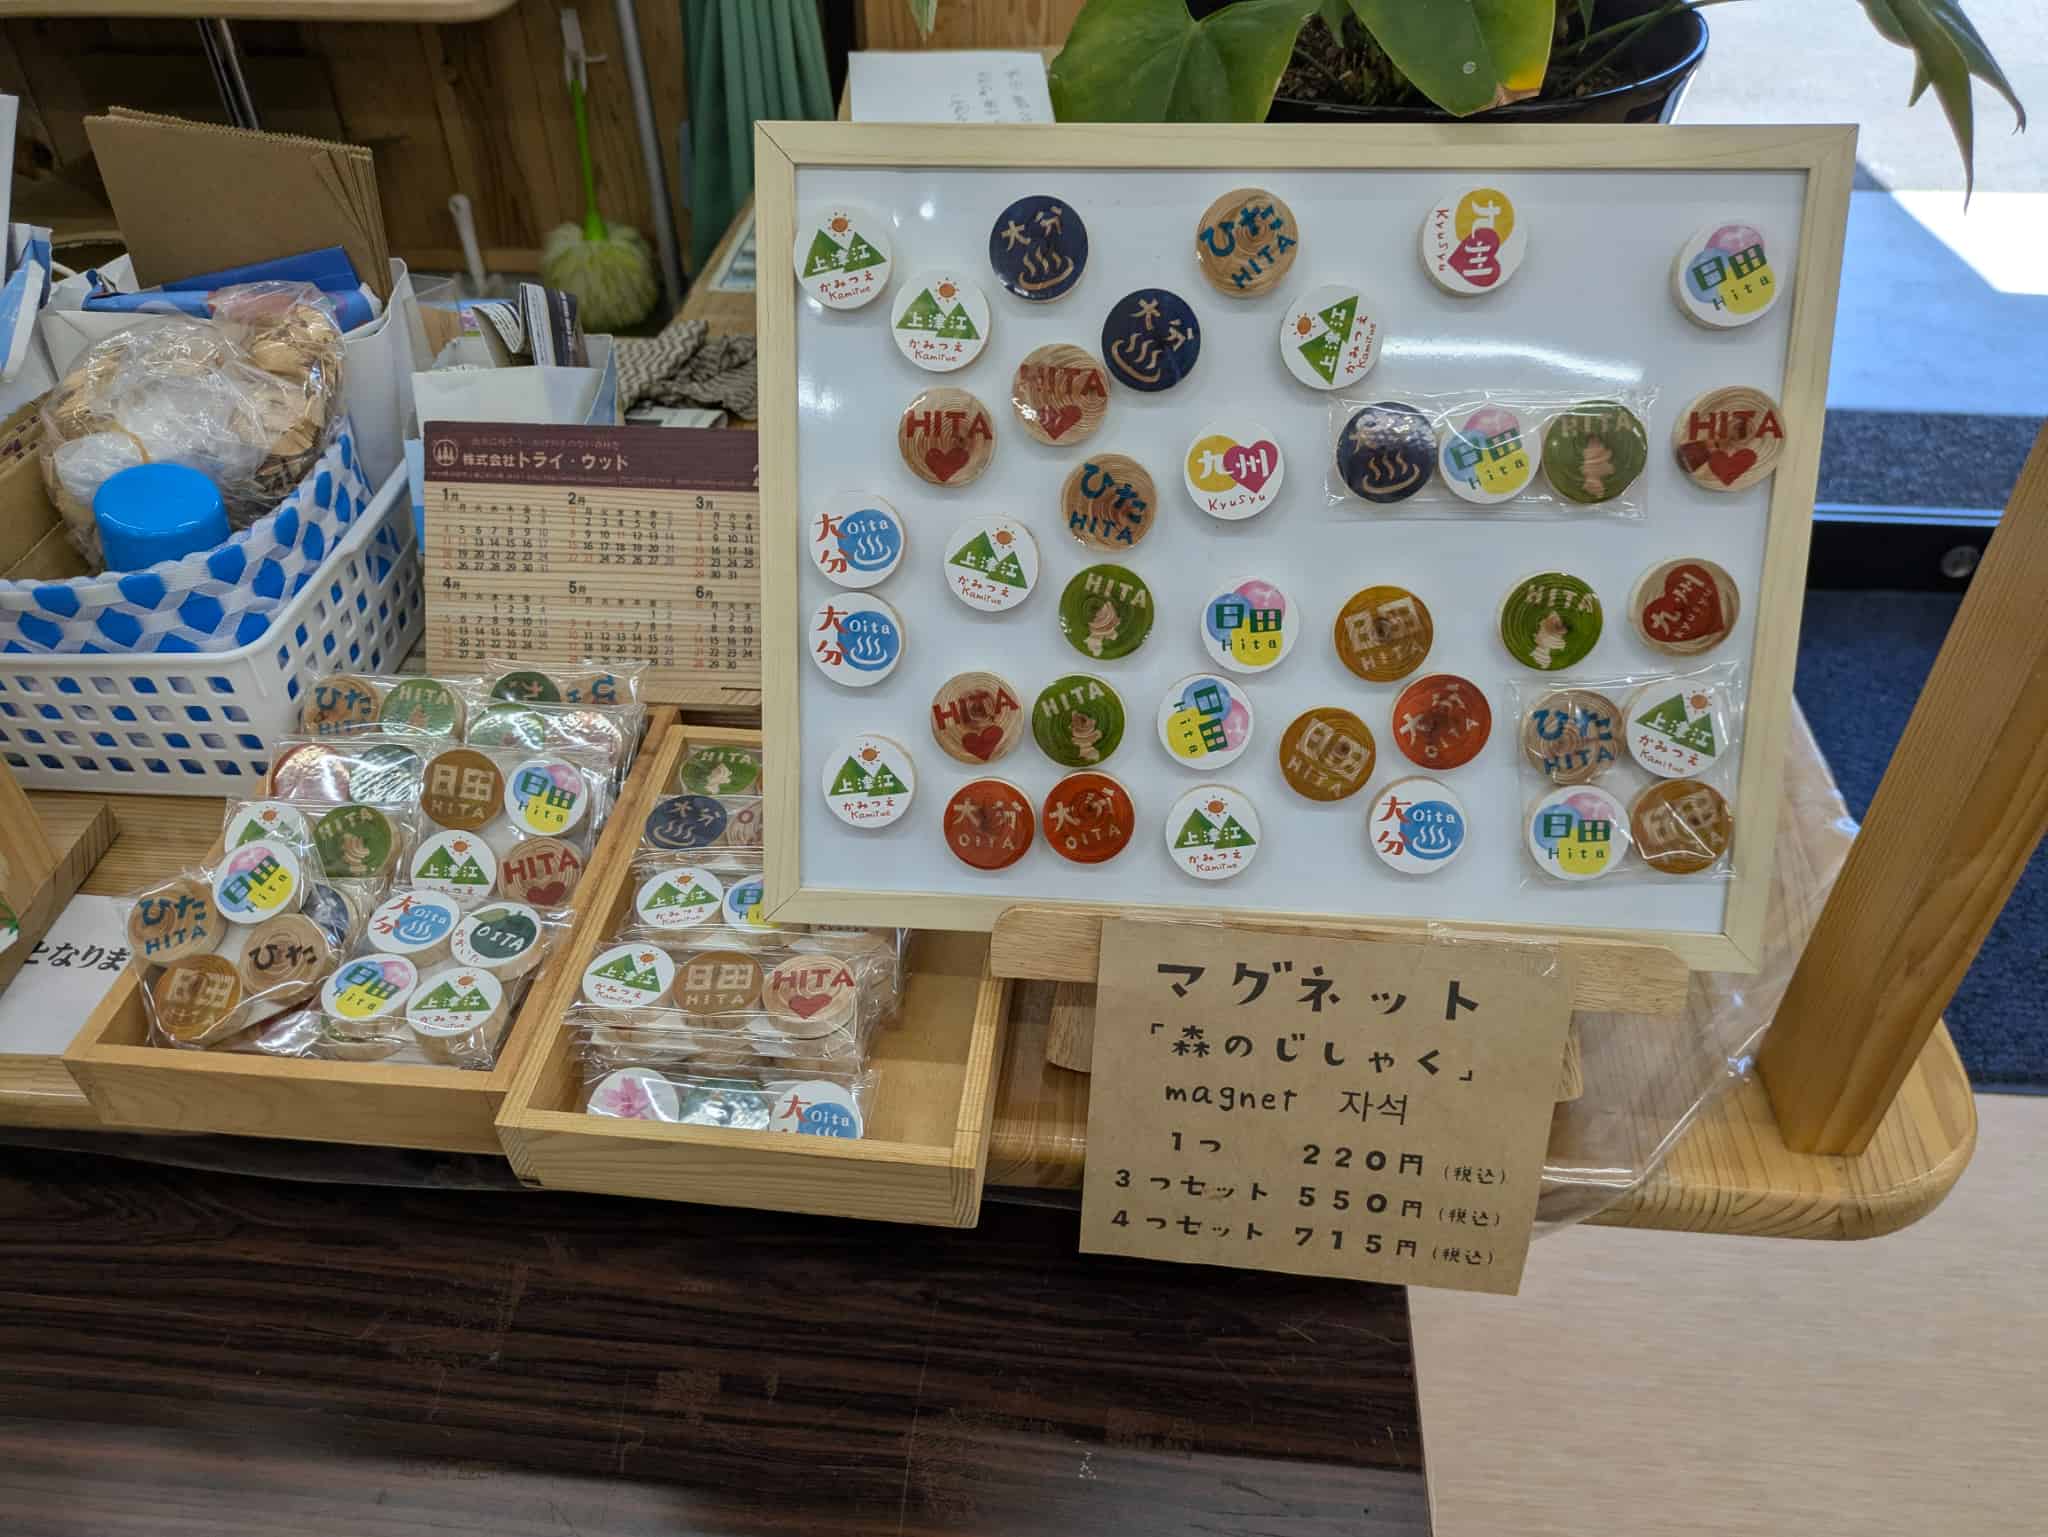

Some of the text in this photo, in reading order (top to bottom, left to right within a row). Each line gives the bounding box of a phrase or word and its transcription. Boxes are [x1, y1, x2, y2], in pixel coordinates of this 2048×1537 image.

[1001, 206, 1062, 251] 大分
[1200, 204, 1285, 257] ひた
[1461, 199, 1502, 277] 九州
[812, 244, 870, 272] 上津江
[1232, 234, 1297, 288] HITA
[1692, 243, 1767, 291] 日田
[820, 270, 874, 293] かみつえ
[1712, 275, 1770, 311] Hita
[907, 312, 967, 330] 上津江
[909, 338, 963, 352] かみつえ
[906, 411, 992, 440] HITA
[1688, 408, 1783, 441] HITA
[1197, 449, 1269, 479] 九州
[1080, 463, 1146, 524] ひた
[847, 519, 889, 534] Oita
[1070, 511, 1133, 545] HITA
[816, 513, 852, 573] 大分
[961, 551, 1018, 577] 上津江
[958, 575, 1010, 598] かみつえ
[1085, 573, 1147, 609] HITA
[1526, 584, 1598, 614] HITA
[849, 619, 890, 635] Oita
[1216, 603, 1282, 633] 日田
[816, 605, 848, 666] 大分
[1222, 638, 1276, 653] Hita
[315, 687, 371, 717] ひた
[933, 687, 1019, 731] HITA
[1041, 681, 1105, 718] HITA
[1194, 685, 1228, 753] 日田
[1533, 709, 1613, 741] ひた
[1645, 712, 1712, 748] 上津江
[701, 751, 752, 765] HITA
[1543, 745, 1615, 775] HITA
[1640, 734, 1699, 766] かみつえ
[433, 764, 496, 801] 日田
[521, 771, 577, 810] 日田
[839, 774, 893, 793] 上津江
[844, 797, 895, 811] かみつえ
[953, 798, 1024, 830] 大分
[1049, 786, 1116, 832] 大分
[1411, 808, 1456, 824] Oita
[1065, 823, 1121, 850] OITA
[1184, 827, 1242, 845] 上津江
[1377, 795, 1413, 855] 大分
[1543, 813, 1611, 842] 日田
[959, 833, 1016, 850] OITA
[1189, 849, 1241, 864] かみつえ
[1548, 847, 1605, 859] Hita
[223, 855, 280, 905] 日田
[426, 863, 478, 879] 上津江
[503, 848, 579, 884] HITA
[138, 895, 206, 926] ひた
[146, 926, 207, 956] HITA
[475, 925, 526, 952] OITA
[248, 944, 318, 970] ひた
[685, 963, 753, 991] 日田
[772, 967, 855, 992] HITA
[1157, 961, 1479, 1021] マグネット
[687, 993, 745, 1006] HITA
[1150, 1023, 1474, 1082] 「森のじしゃく」
[1165, 1085, 1298, 1112] magnet
[1339, 1090, 1409, 1125] 자석
[810, 1109, 850, 1127] Oita
[1170, 1132, 1222, 1152] 1つ
[1303, 1144, 1423, 1176] 220円
[1114, 1170, 1268, 1201] 3つセット
[1298, 1187, 1423, 1219] 550円
[1111, 1210, 1263, 1240] 4つセット
[1294, 1228, 1417, 1257] 715円
